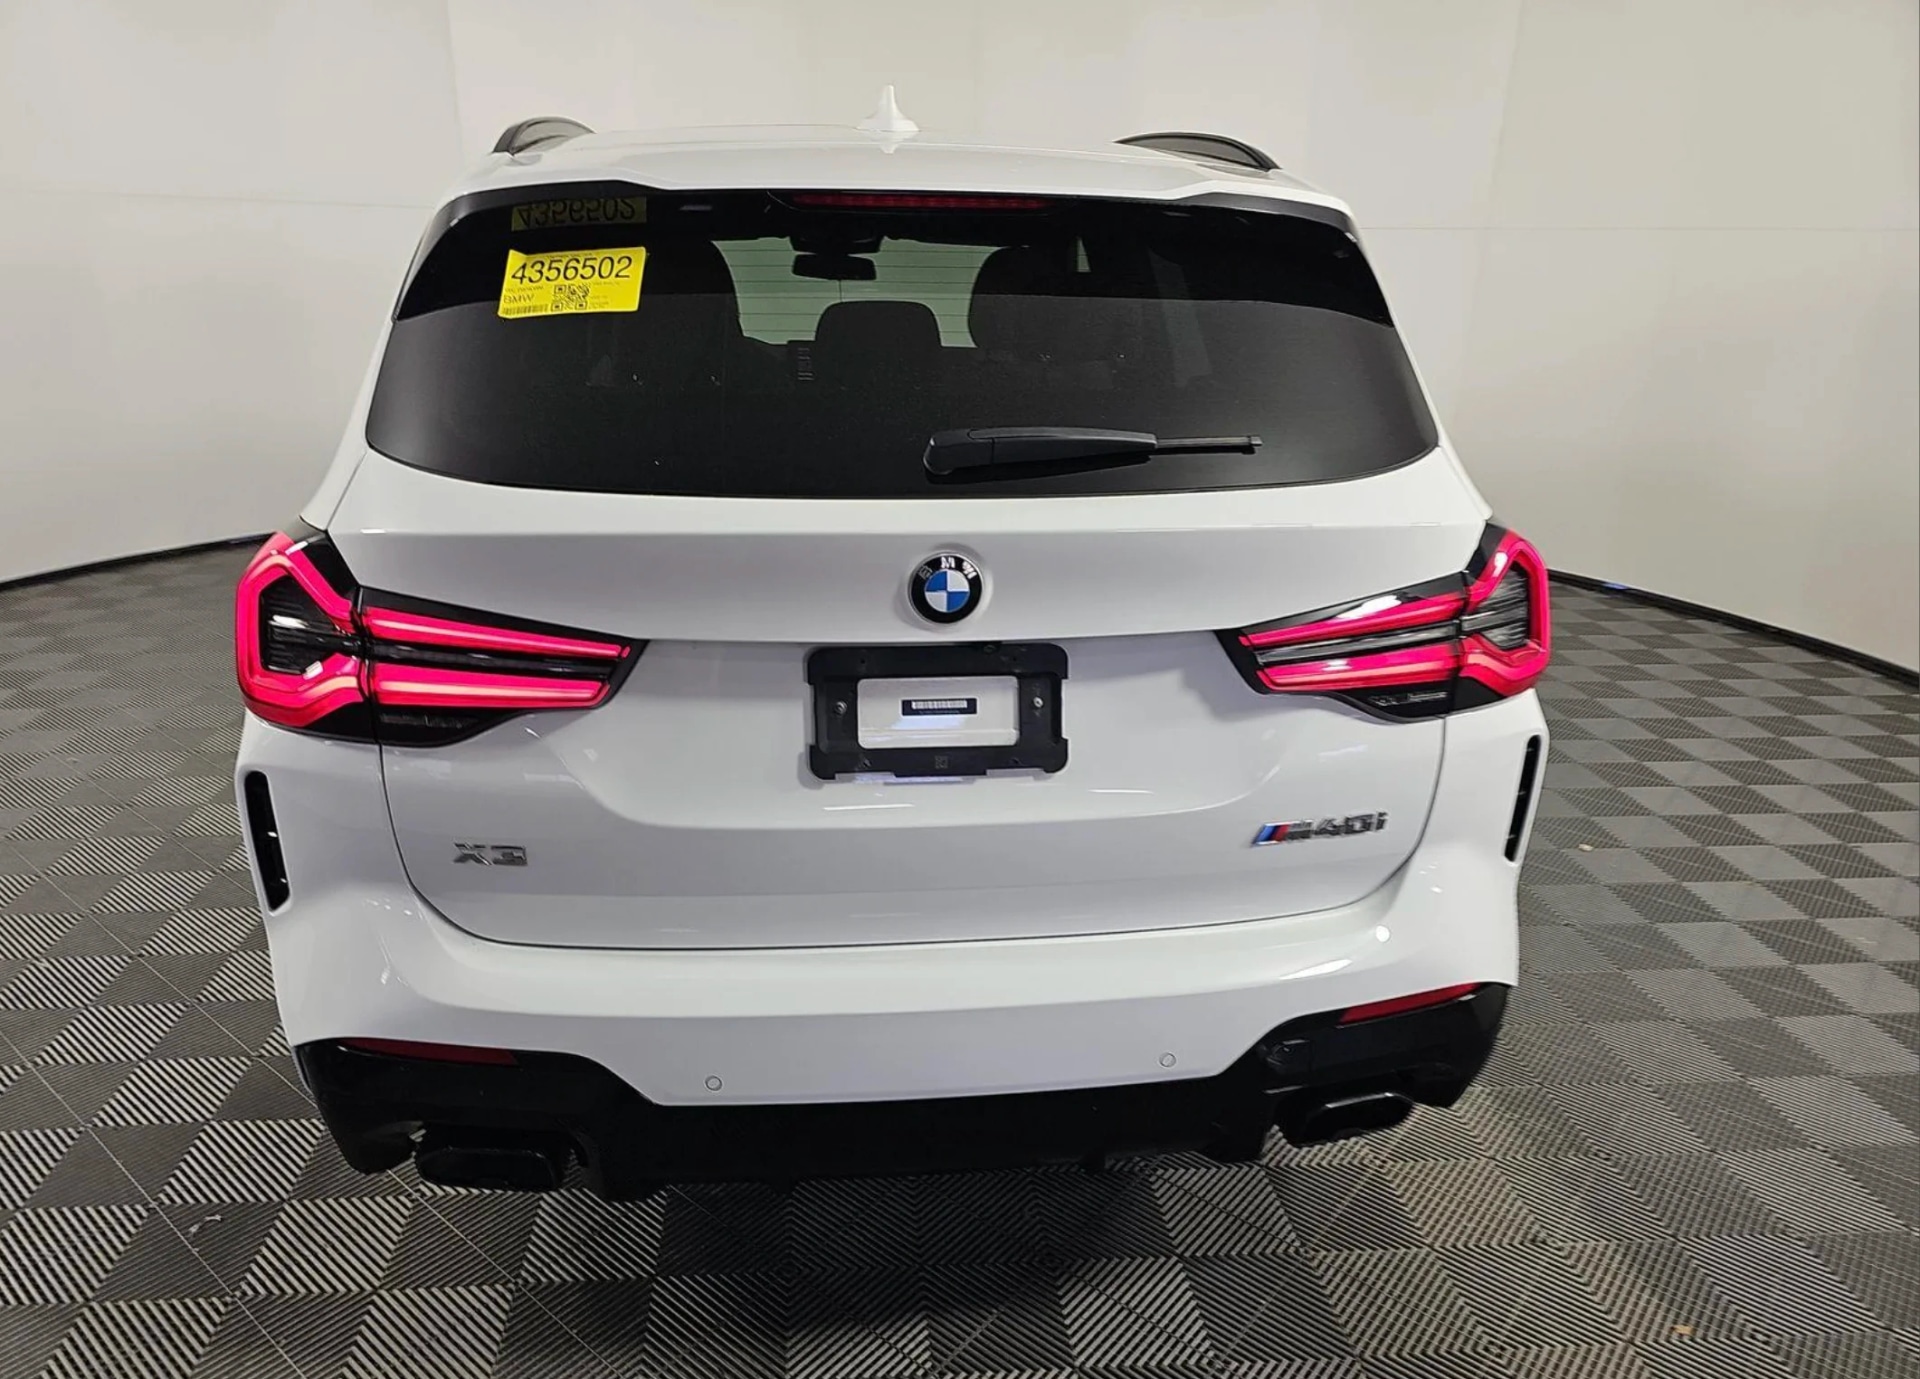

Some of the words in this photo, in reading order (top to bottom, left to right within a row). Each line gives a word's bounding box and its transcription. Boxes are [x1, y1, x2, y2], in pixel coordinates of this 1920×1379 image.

[511, 255, 633, 285] 4356502
[503, 293, 534, 304] BMW
[918, 556, 977, 580] BMW
[453, 842, 528, 867] X3
